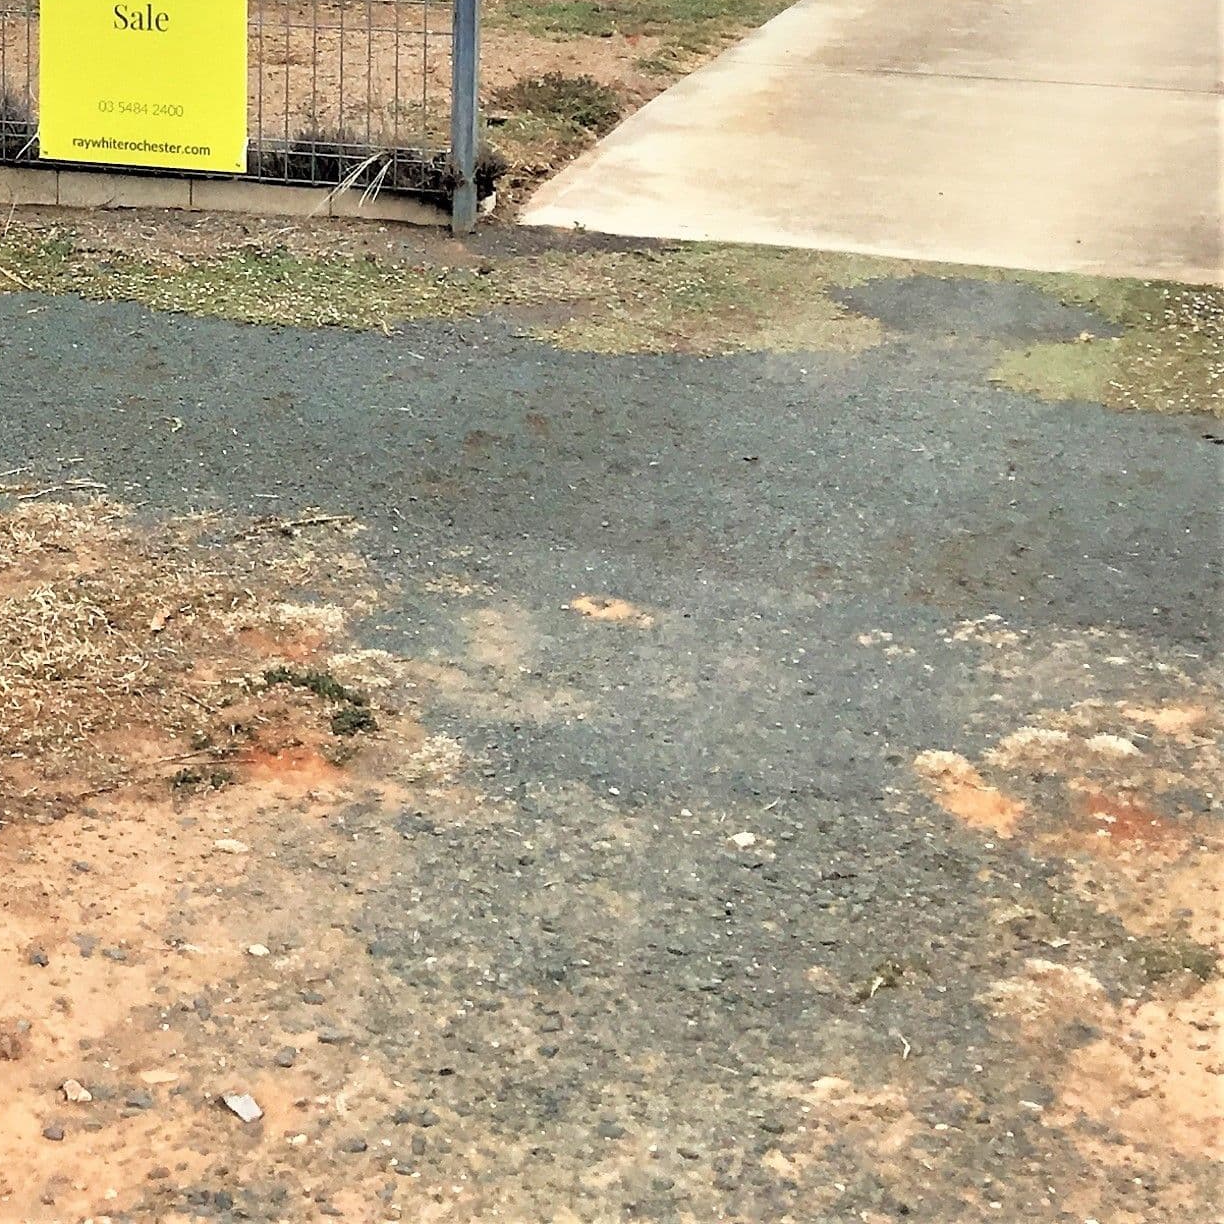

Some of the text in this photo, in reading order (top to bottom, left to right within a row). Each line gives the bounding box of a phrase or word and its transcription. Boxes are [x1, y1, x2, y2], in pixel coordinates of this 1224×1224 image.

[113, 3, 170, 33] Sale
[98, 100, 185, 118] 03 5484 2400
[72, 135, 211, 157] raywhiterochester.com
